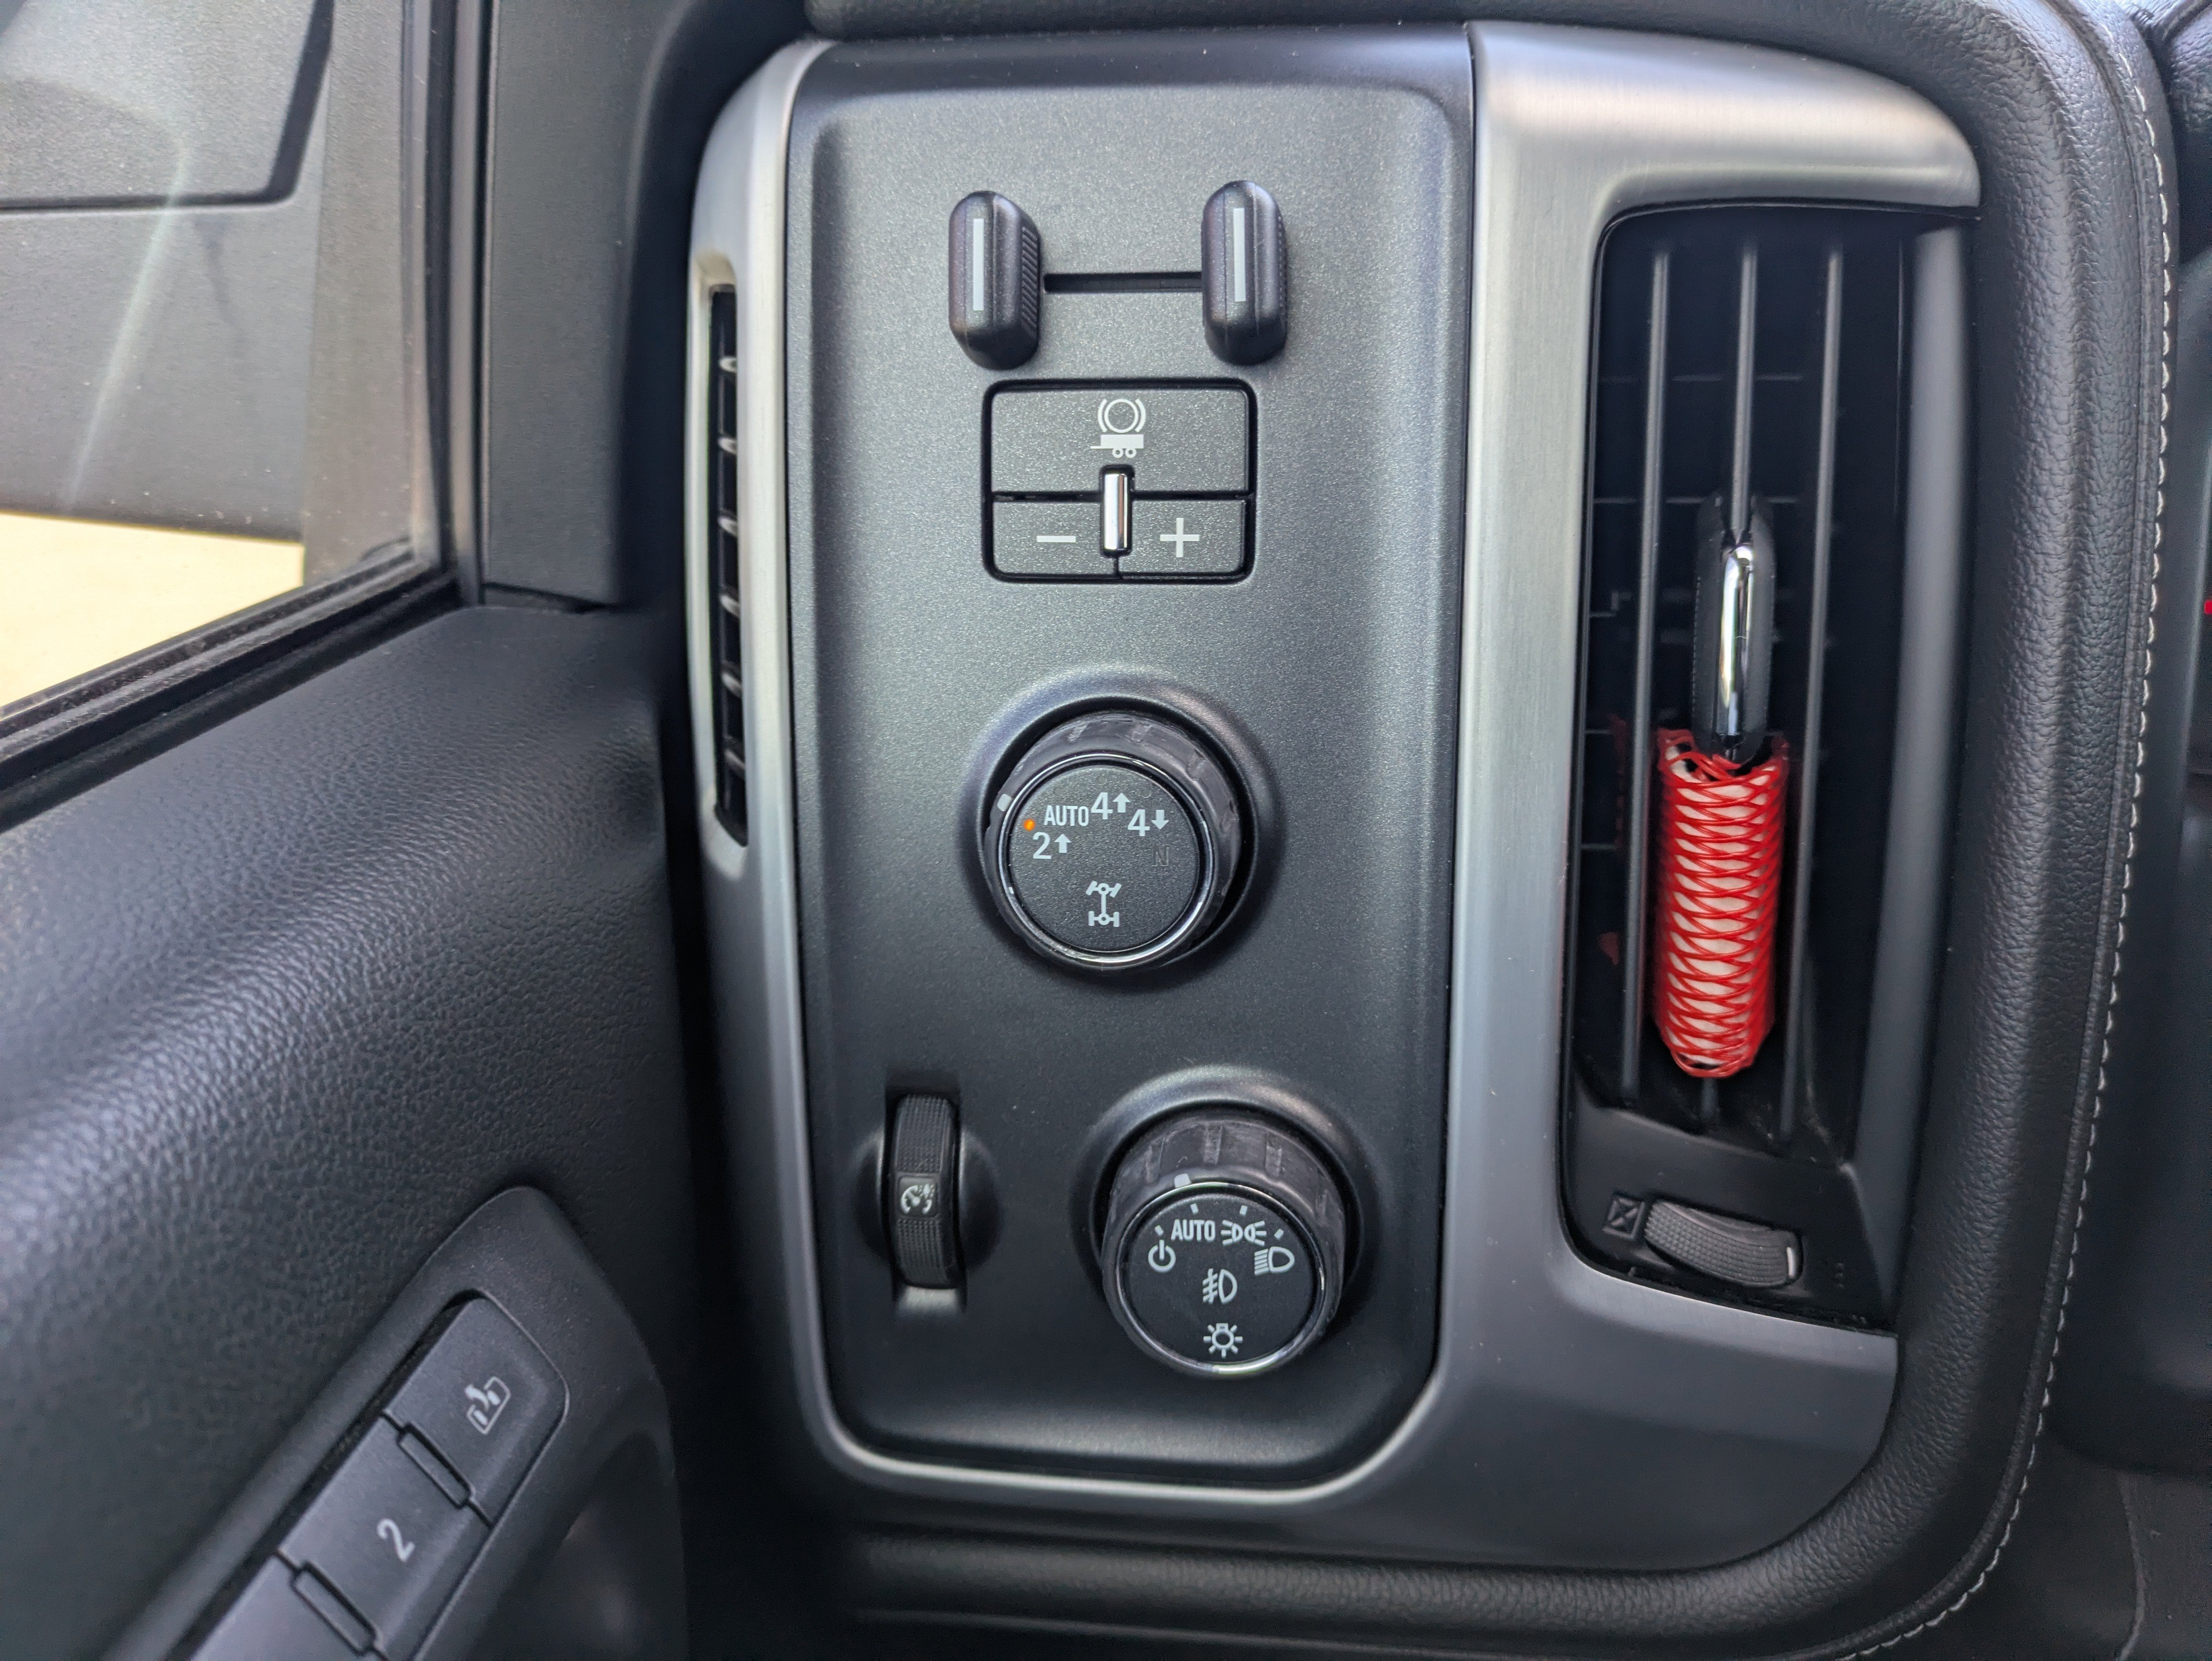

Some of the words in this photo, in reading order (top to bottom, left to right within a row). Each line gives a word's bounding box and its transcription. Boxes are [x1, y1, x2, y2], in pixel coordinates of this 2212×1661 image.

[1044, 805, 1089, 826] AUTO
[1091, 792, 1113, 820] 4
[1128, 809, 1150, 837] 4
[1032, 832, 1051, 860] 2
[1152, 846, 1169, 866] N
[1171, 1219, 1216, 1241] AUTO
[377, 1518, 415, 1562] 2
